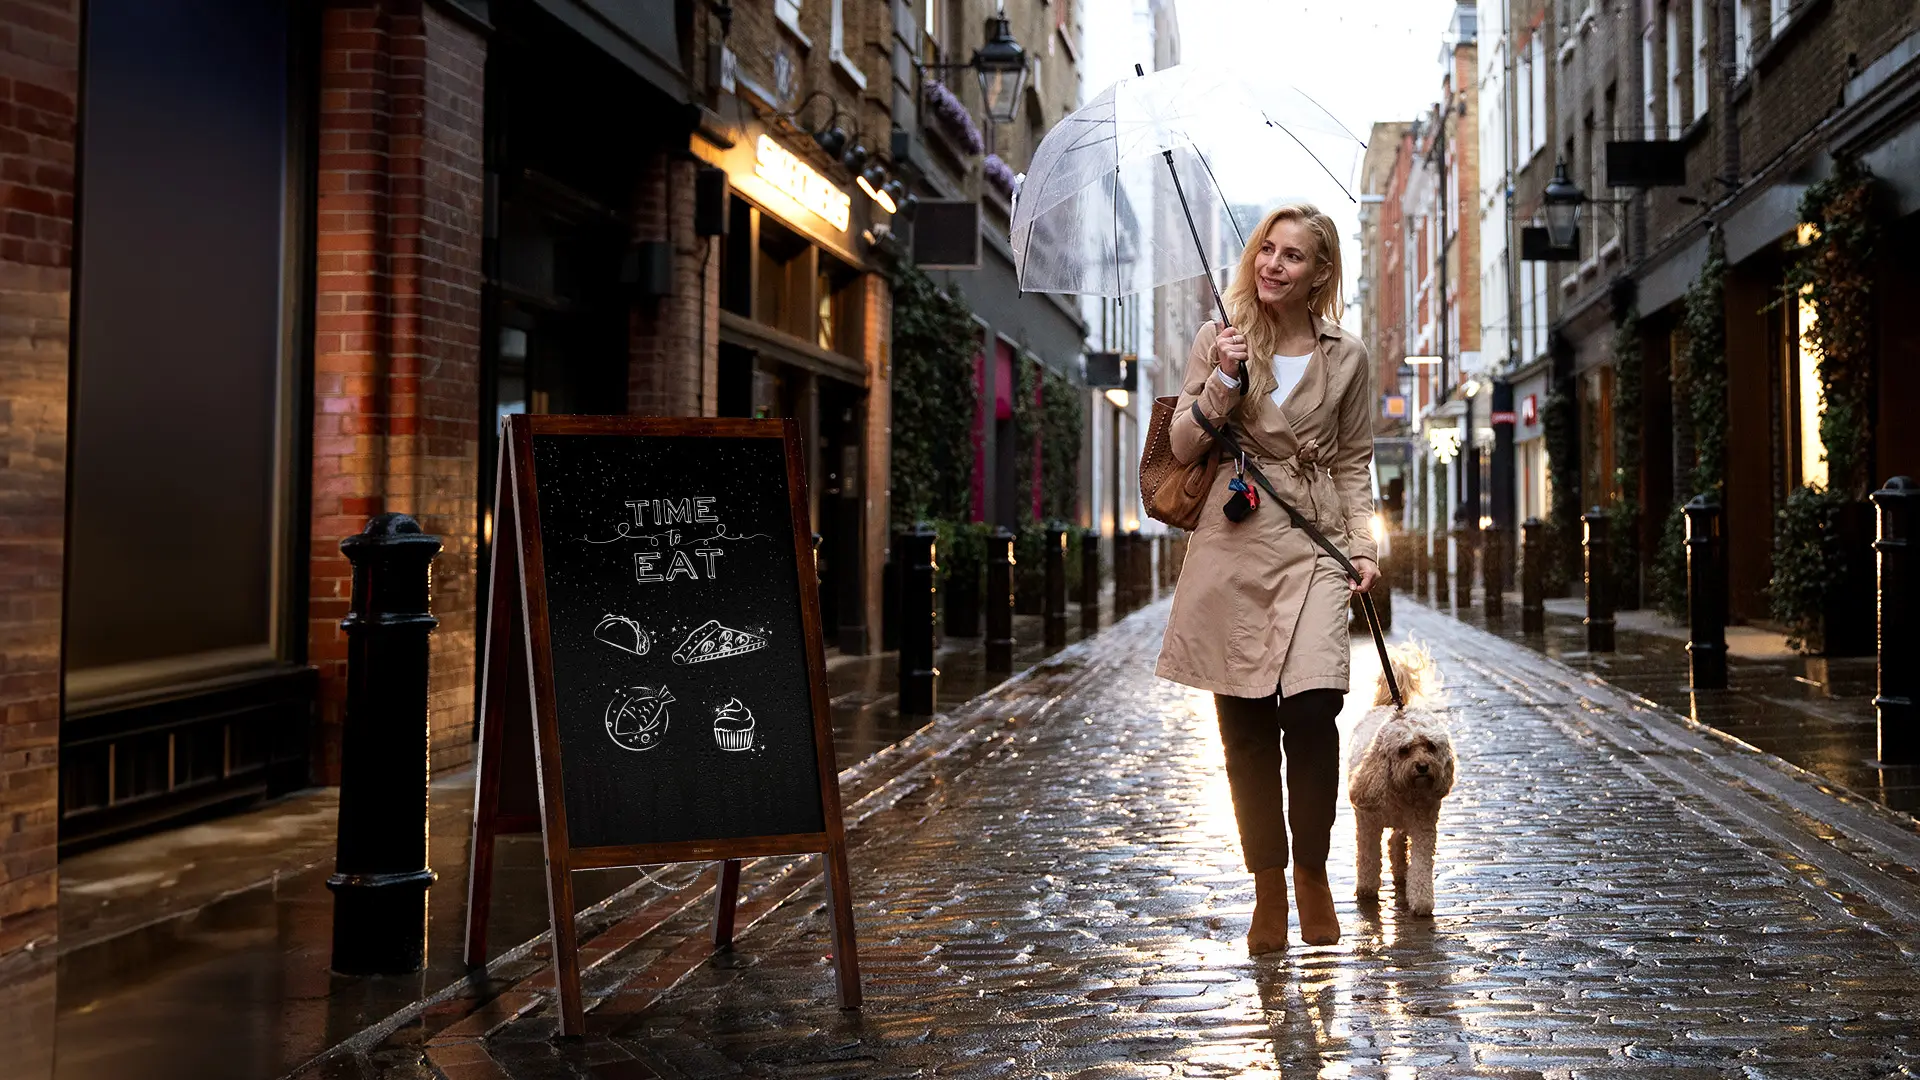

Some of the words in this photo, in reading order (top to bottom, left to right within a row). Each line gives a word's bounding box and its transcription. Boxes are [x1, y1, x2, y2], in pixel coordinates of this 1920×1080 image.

[625, 496, 719, 527] TIME
[665, 529, 681, 546] to
[634, 548, 724, 583] EAT
